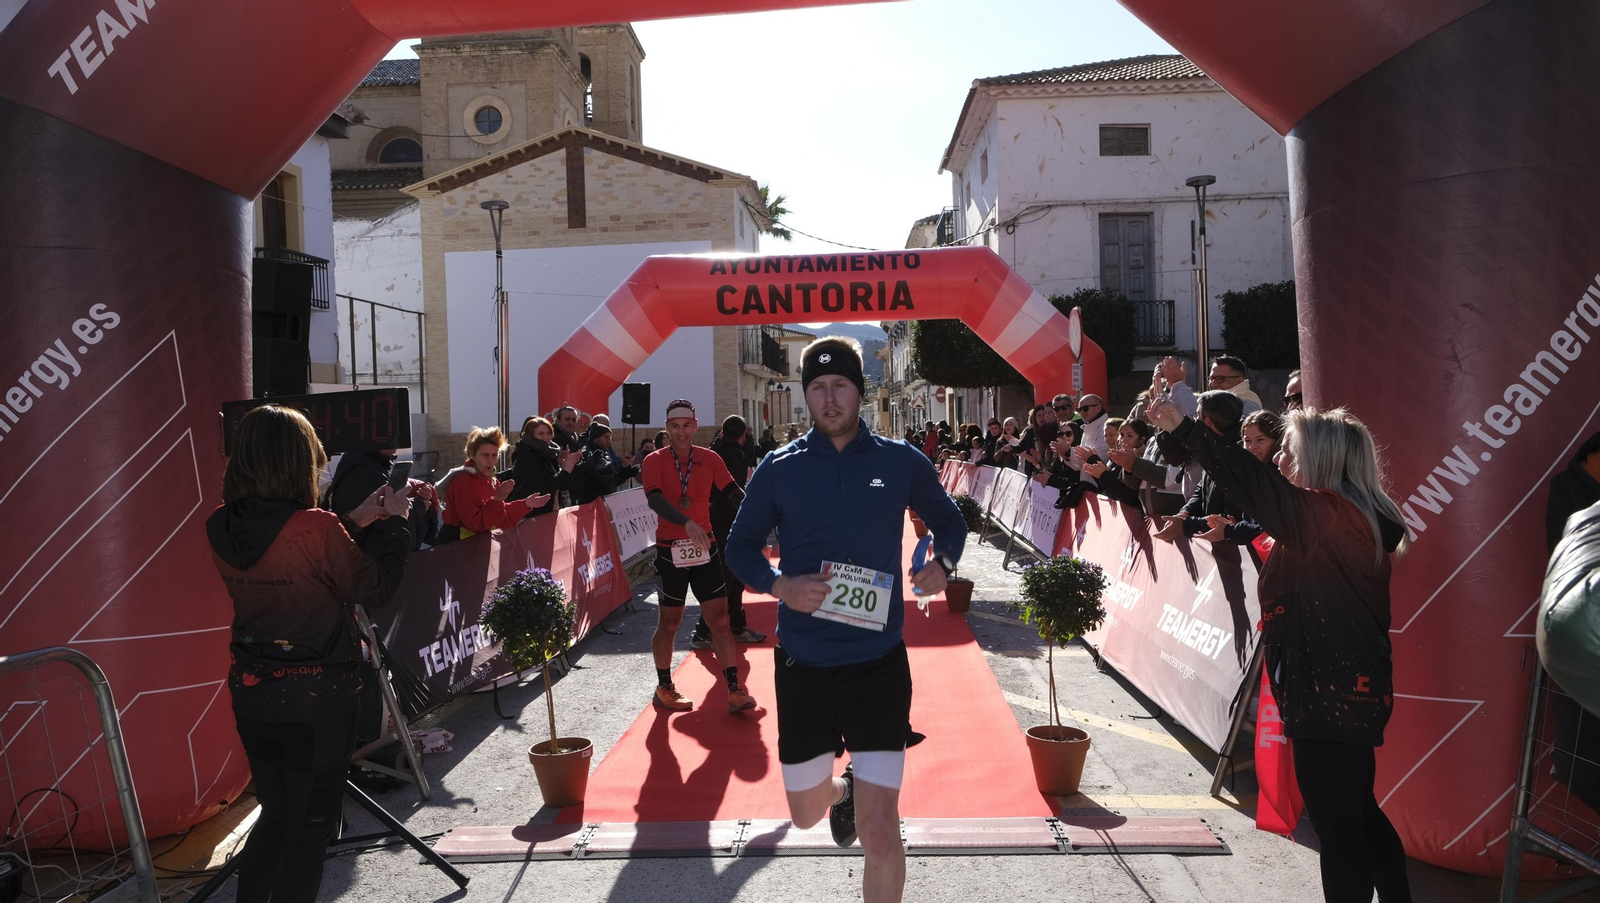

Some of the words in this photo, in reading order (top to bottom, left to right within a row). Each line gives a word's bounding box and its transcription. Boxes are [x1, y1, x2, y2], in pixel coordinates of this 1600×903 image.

[709, 252, 921, 275] AYUNTAMIENTO
[716, 280, 915, 315] CANTORIA
[1401, 274, 1600, 542] www.teamerg
[577, 550, 615, 586] TEAMERGY
[679, 547, 702, 560] 326
[833, 563, 843, 571] IV
[844, 564, 863, 575] CxM
[840, 572, 872, 585] PÓLVORA
[832, 583, 878, 613] 280
[1156, 603, 1233, 660] TEAMERGY
